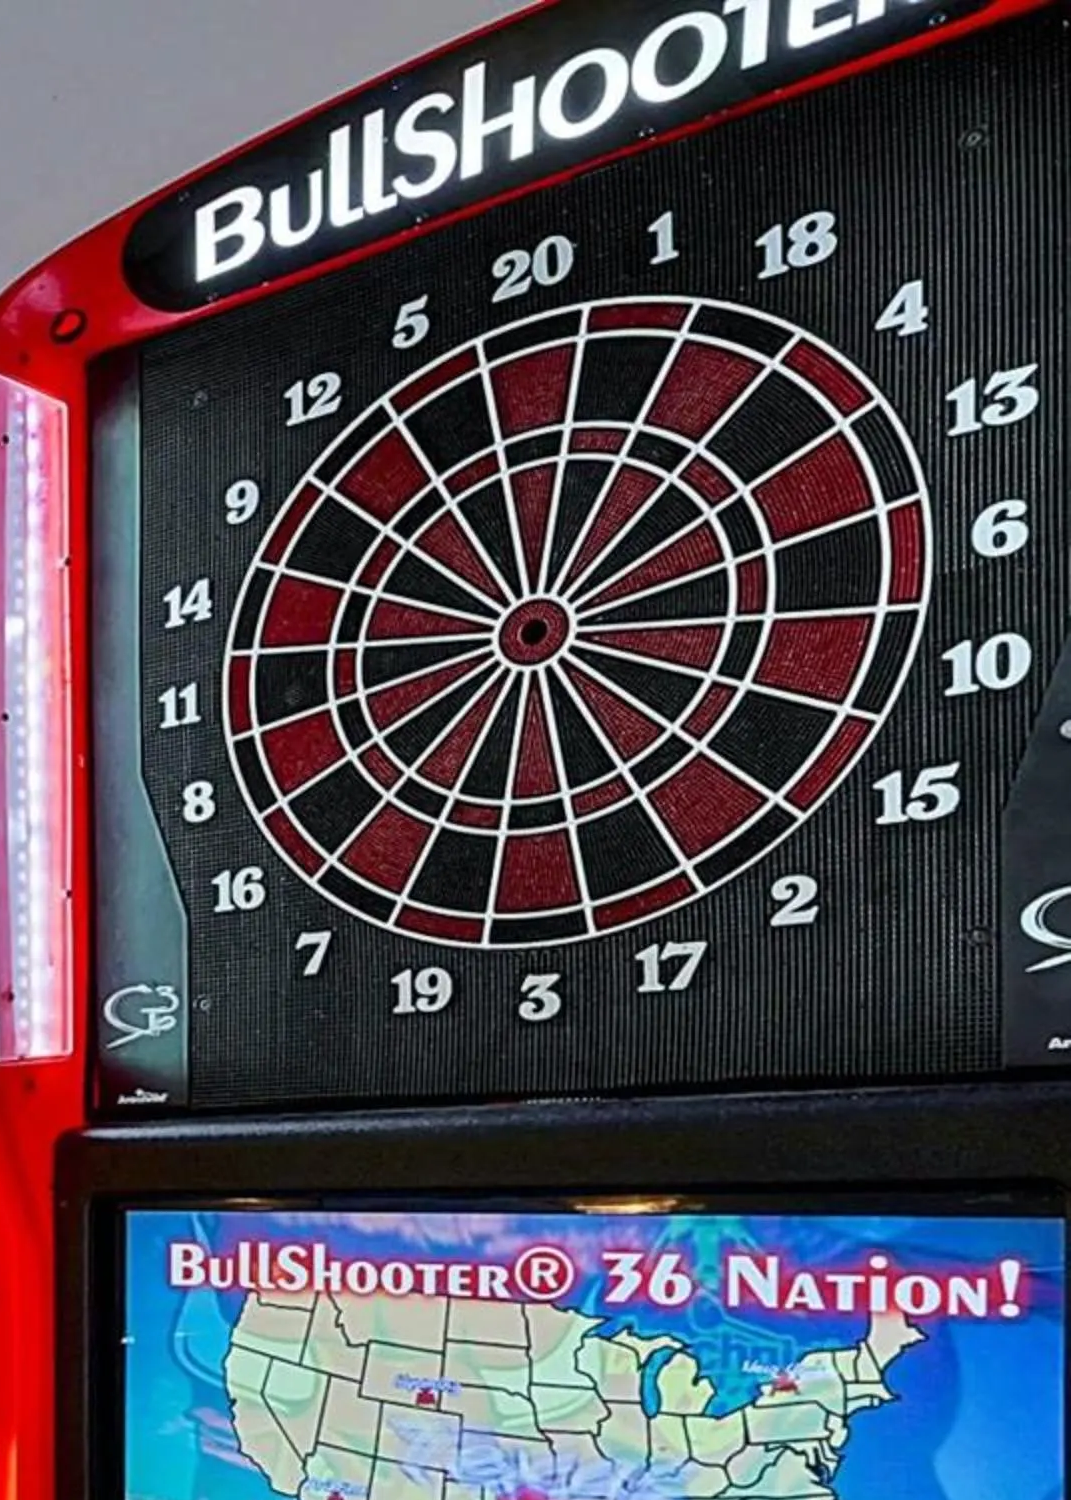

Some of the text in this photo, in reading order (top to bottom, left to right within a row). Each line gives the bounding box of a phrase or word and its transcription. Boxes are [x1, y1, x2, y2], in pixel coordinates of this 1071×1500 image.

[649, 212, 678, 264] 1
[756, 212, 837, 278] 18
[492, 236, 574, 303] 20
[393, 295, 430, 349] 5
[875, 280, 928, 336] 4
[284, 373, 342, 427] 12
[946, 363, 1039, 437] 13
[225, 480, 259, 525] 9
[971, 500, 1029, 558] 6
[163, 578, 212, 630] 14
[942, 633, 1031, 697] 10
[158, 683, 202, 729] 11
[182, 781, 216, 823] 8
[873, 762, 963, 825] 15
[211, 866, 266, 913] 16
[770, 875, 819, 927] 2
[295, 932, 332, 976] 7
[635, 941, 708, 993] 17
[390, 967, 453, 1014] 19
[518, 974, 562, 1021] 3
[602, 1252, 692, 1305] 36
